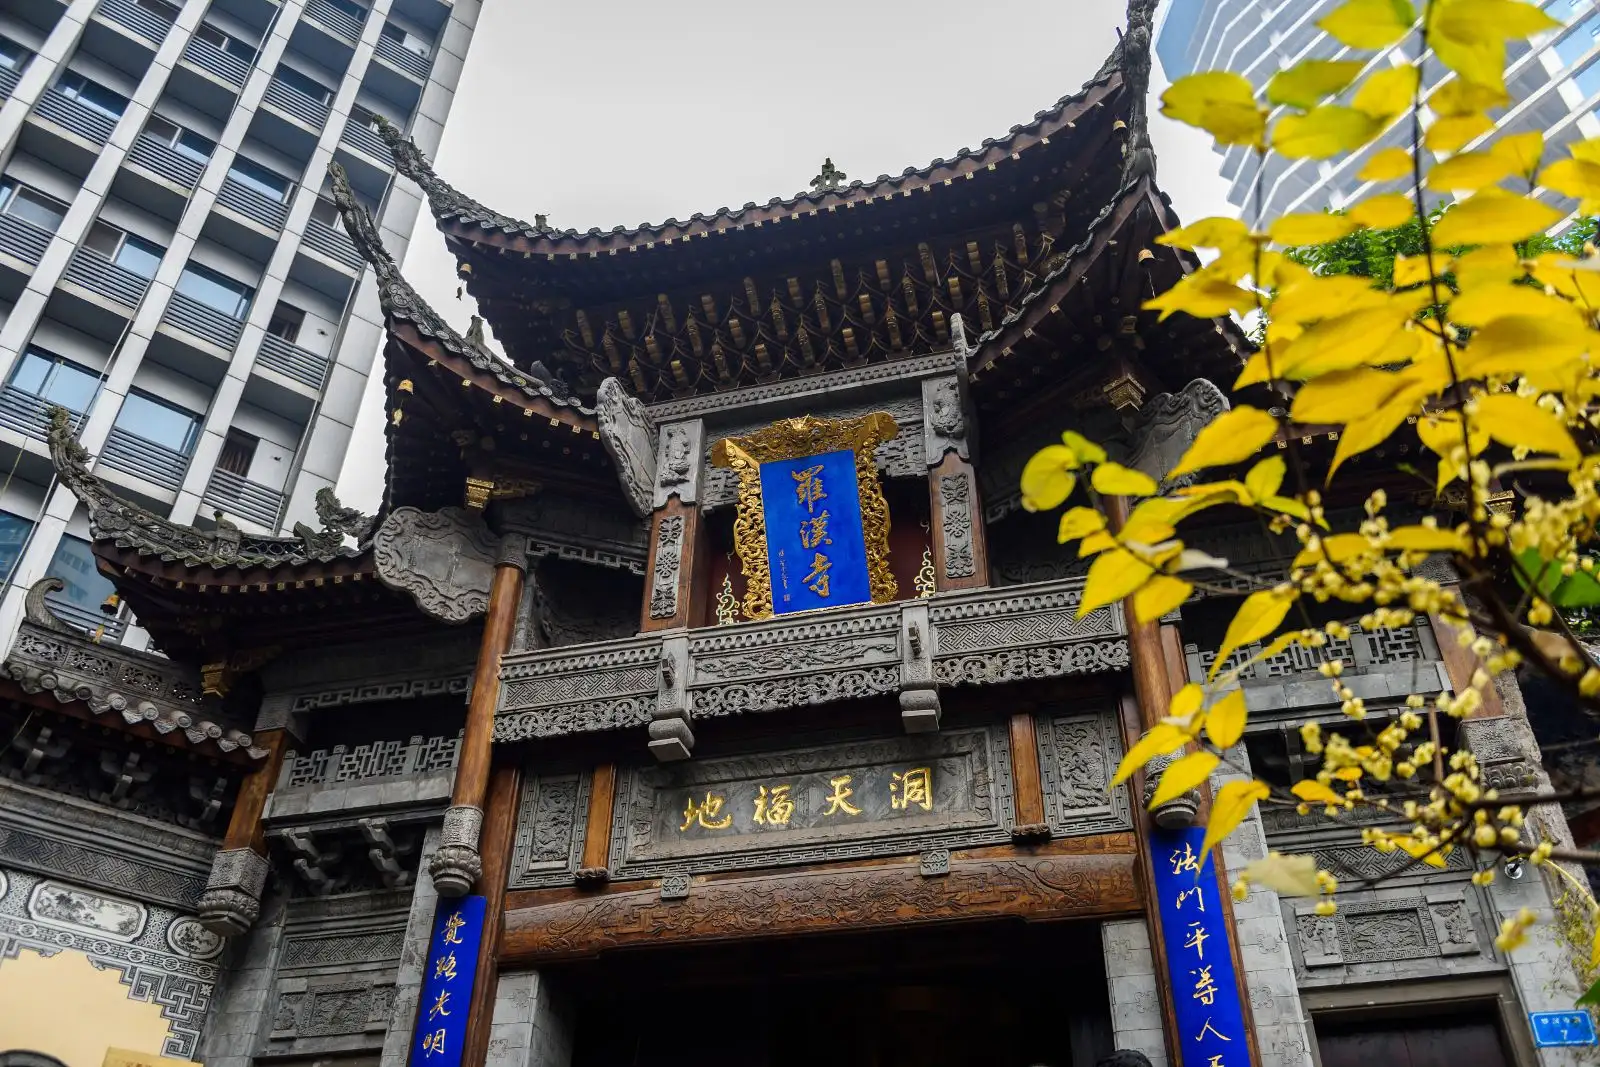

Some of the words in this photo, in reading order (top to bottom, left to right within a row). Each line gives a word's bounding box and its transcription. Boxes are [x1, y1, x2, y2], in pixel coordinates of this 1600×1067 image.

[791, 464, 833, 598] 羅漢寺
[1560, 1029, 1568, 1040] 7
